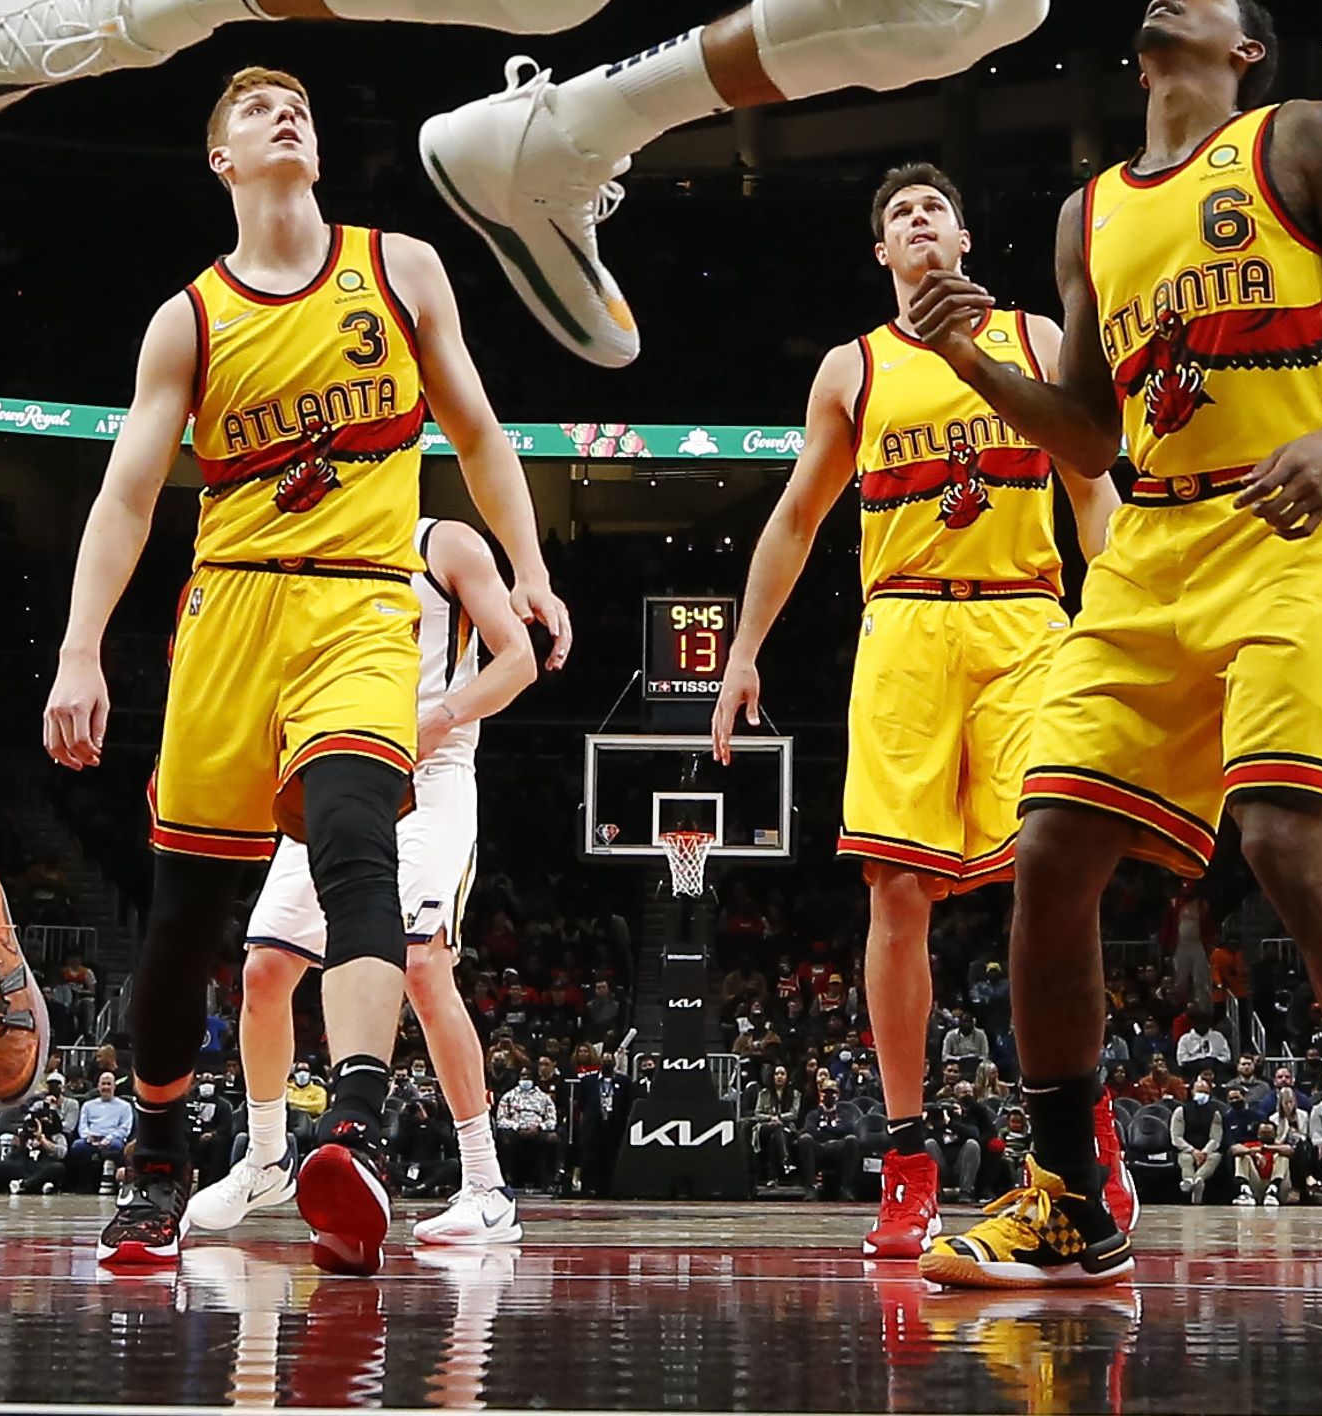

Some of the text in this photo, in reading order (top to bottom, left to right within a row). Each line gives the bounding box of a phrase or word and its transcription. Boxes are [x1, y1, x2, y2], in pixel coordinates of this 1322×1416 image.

[1200, 185, 1256, 253] 6
[339, 308, 388, 369] 3
[222, 374, 399, 455] ATLANTA
[881, 413, 1031, 467] ATLANT
[671, 605, 724, 630] 9:45
[679, 632, 717, 672] 13
